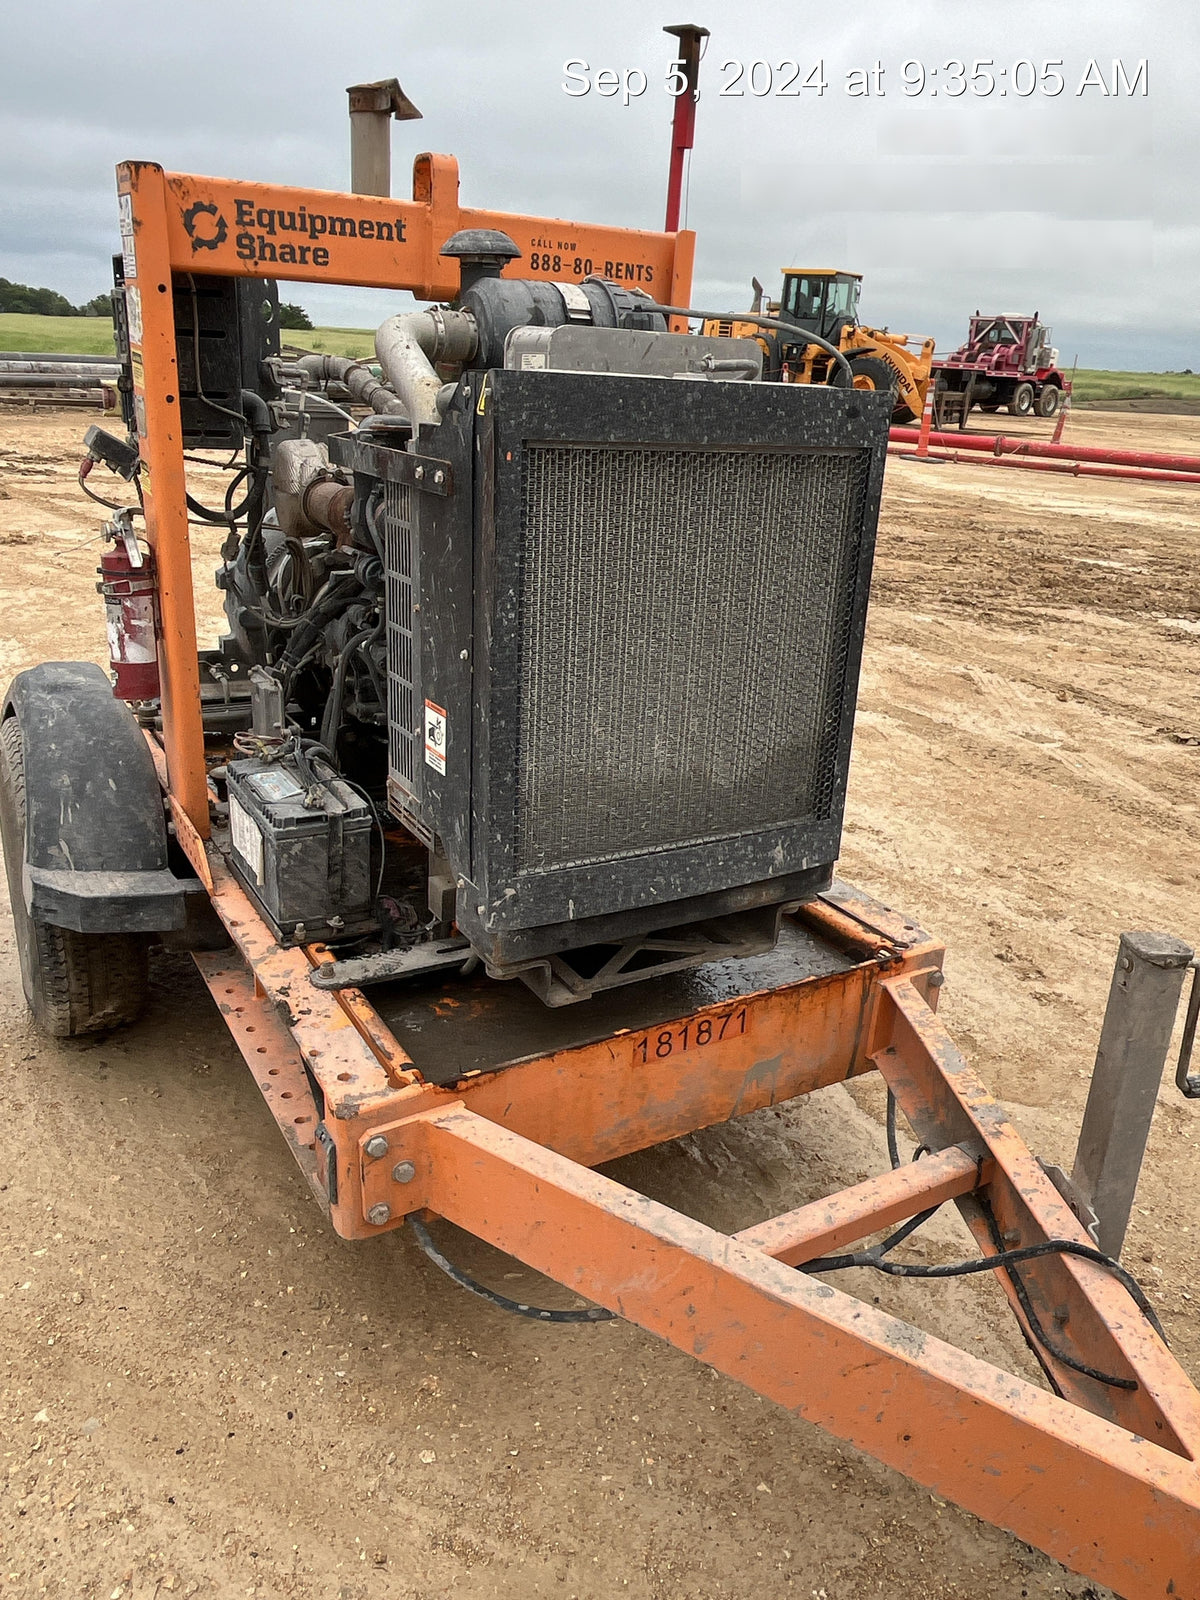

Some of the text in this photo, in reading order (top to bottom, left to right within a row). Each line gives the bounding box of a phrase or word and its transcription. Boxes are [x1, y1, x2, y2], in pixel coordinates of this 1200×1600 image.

[234, 199, 407, 243] Equipment
[236, 232, 329, 267] Share
[531, 238, 577, 251] CALL NOW
[530, 252, 654, 282] 888-80-RENTS
[881, 352, 915, 395] HYUNDAI
[637, 1008, 747, 1063] 181871
